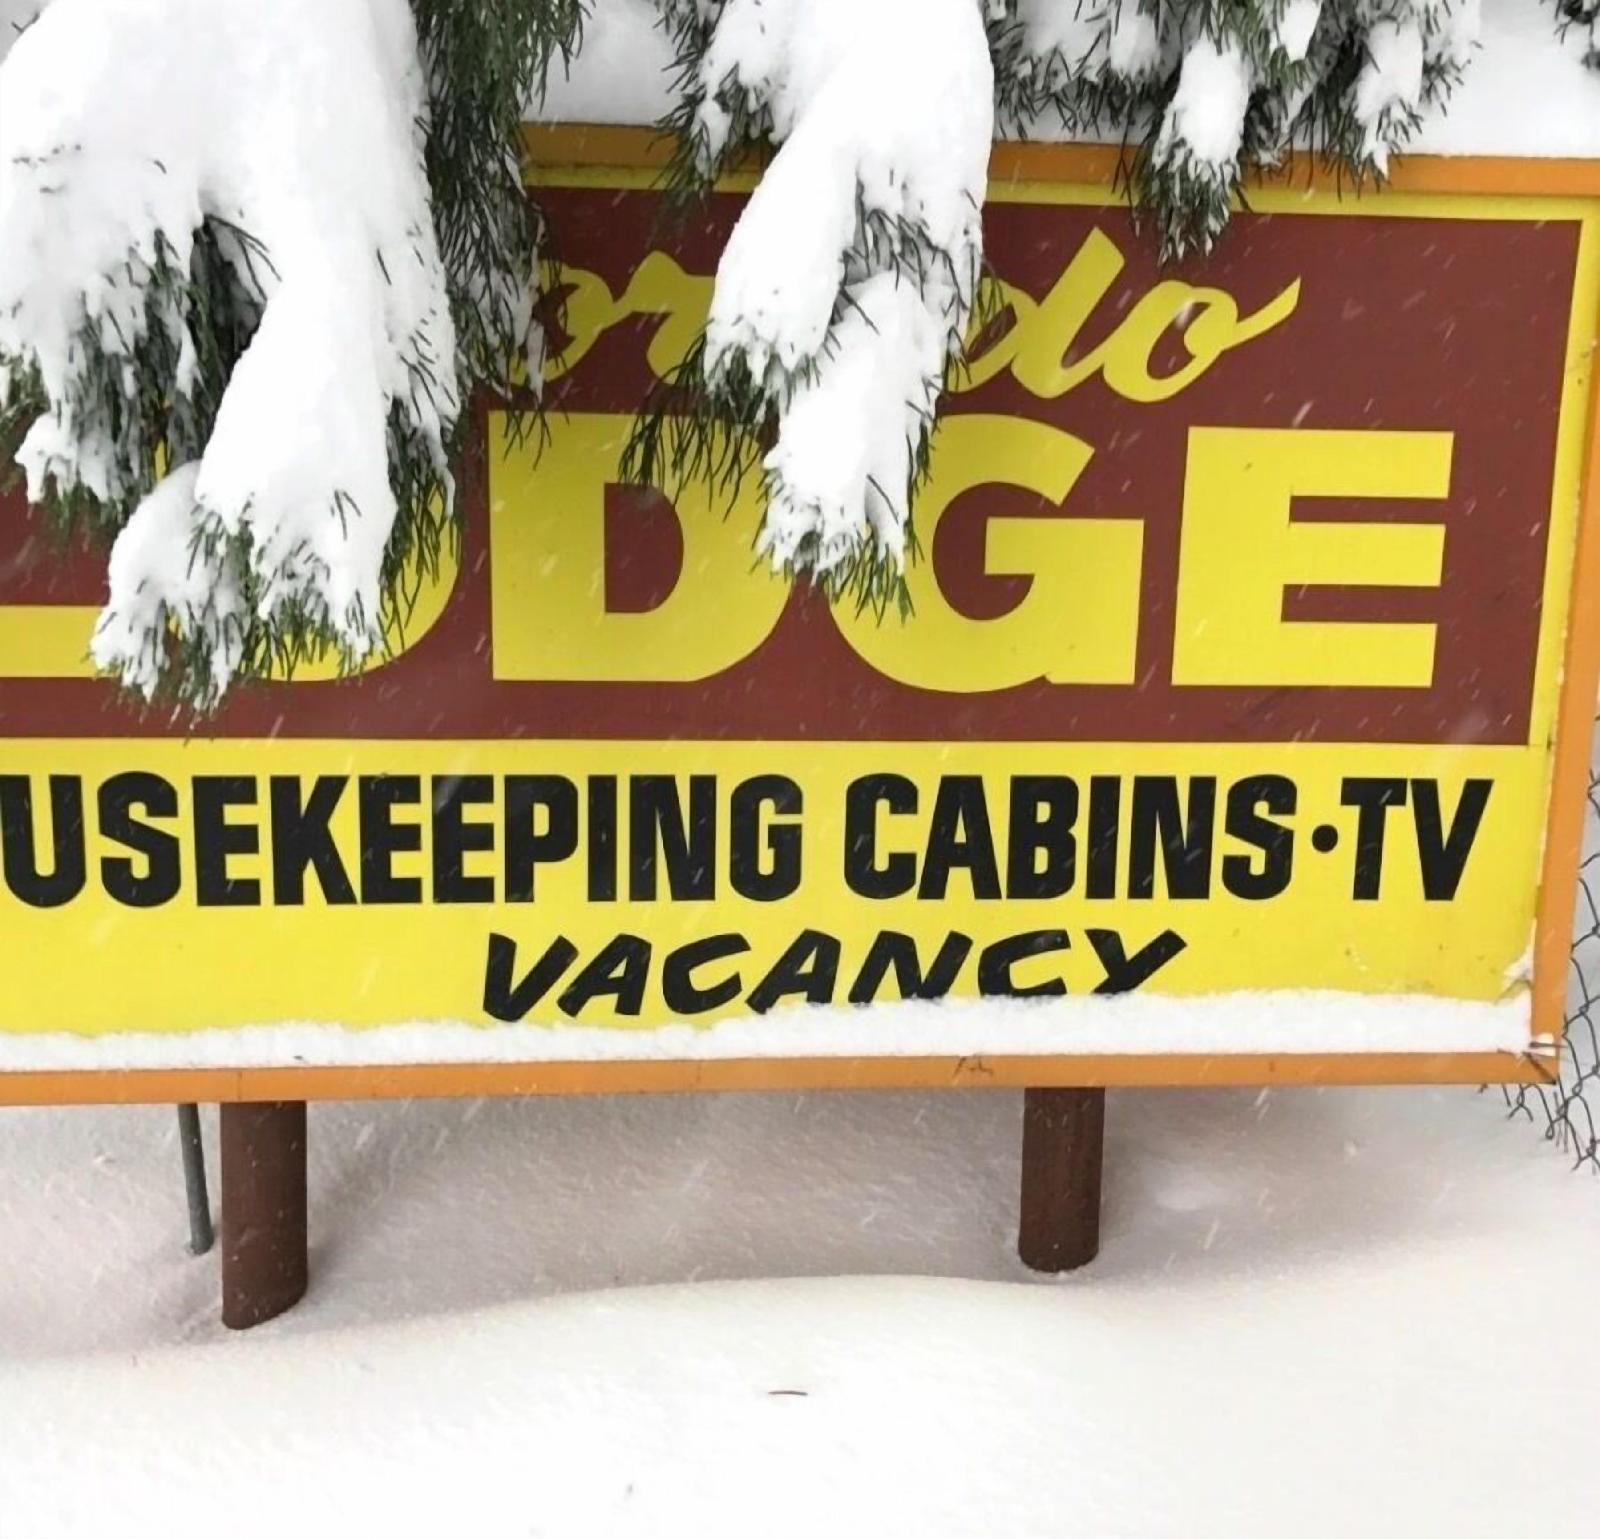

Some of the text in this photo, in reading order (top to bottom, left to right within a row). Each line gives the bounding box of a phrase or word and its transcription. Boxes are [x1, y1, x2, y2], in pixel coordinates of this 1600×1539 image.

[0, 411, 1454, 693] DGE
[0, 770, 804, 908] USEKEEPING
[481, 929, 1186, 1022] VACANCY
